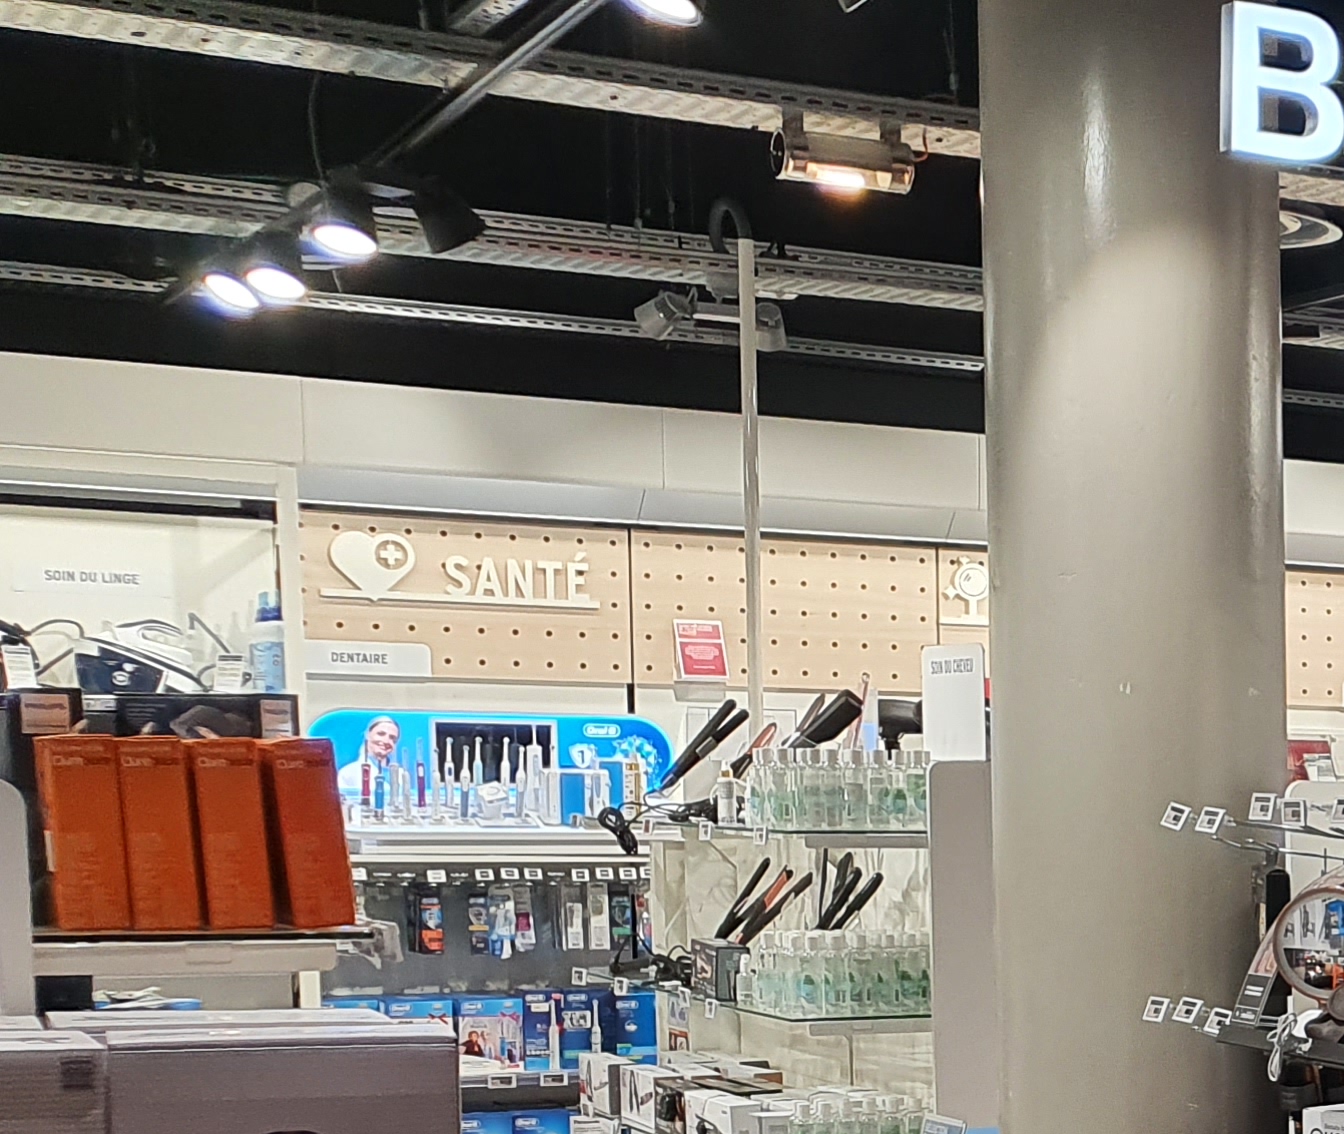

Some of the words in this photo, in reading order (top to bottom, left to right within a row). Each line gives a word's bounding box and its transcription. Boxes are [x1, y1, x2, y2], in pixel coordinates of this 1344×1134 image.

[44, 569, 76, 583] SOIN
[79, 571, 97, 583] DU
[101, 572, 140, 586] LINGE
[444, 551, 591, 600] SANTÉ
[331, 651, 388, 665] DENTAIRE
